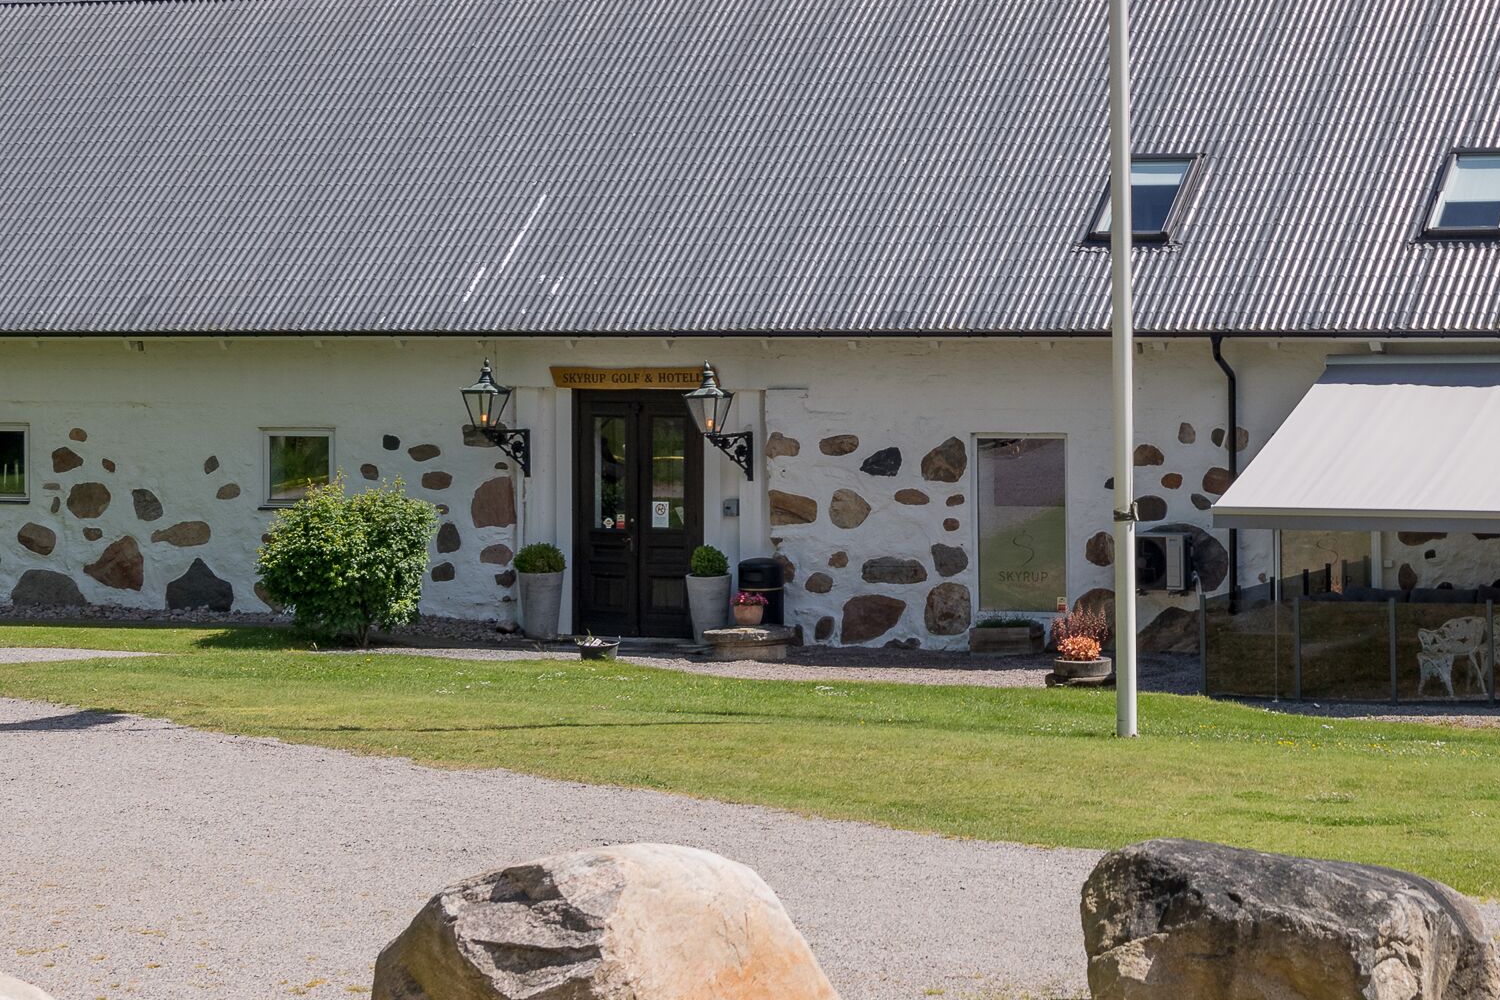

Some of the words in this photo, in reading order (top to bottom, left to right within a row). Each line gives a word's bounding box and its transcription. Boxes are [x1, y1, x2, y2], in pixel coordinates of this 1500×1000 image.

[563, 372, 606, 384] SKYRUP
[611, 372, 640, 384] GOLF
[645, 373, 653, 383] &
[998, 570, 1049, 583] SKYRUP
